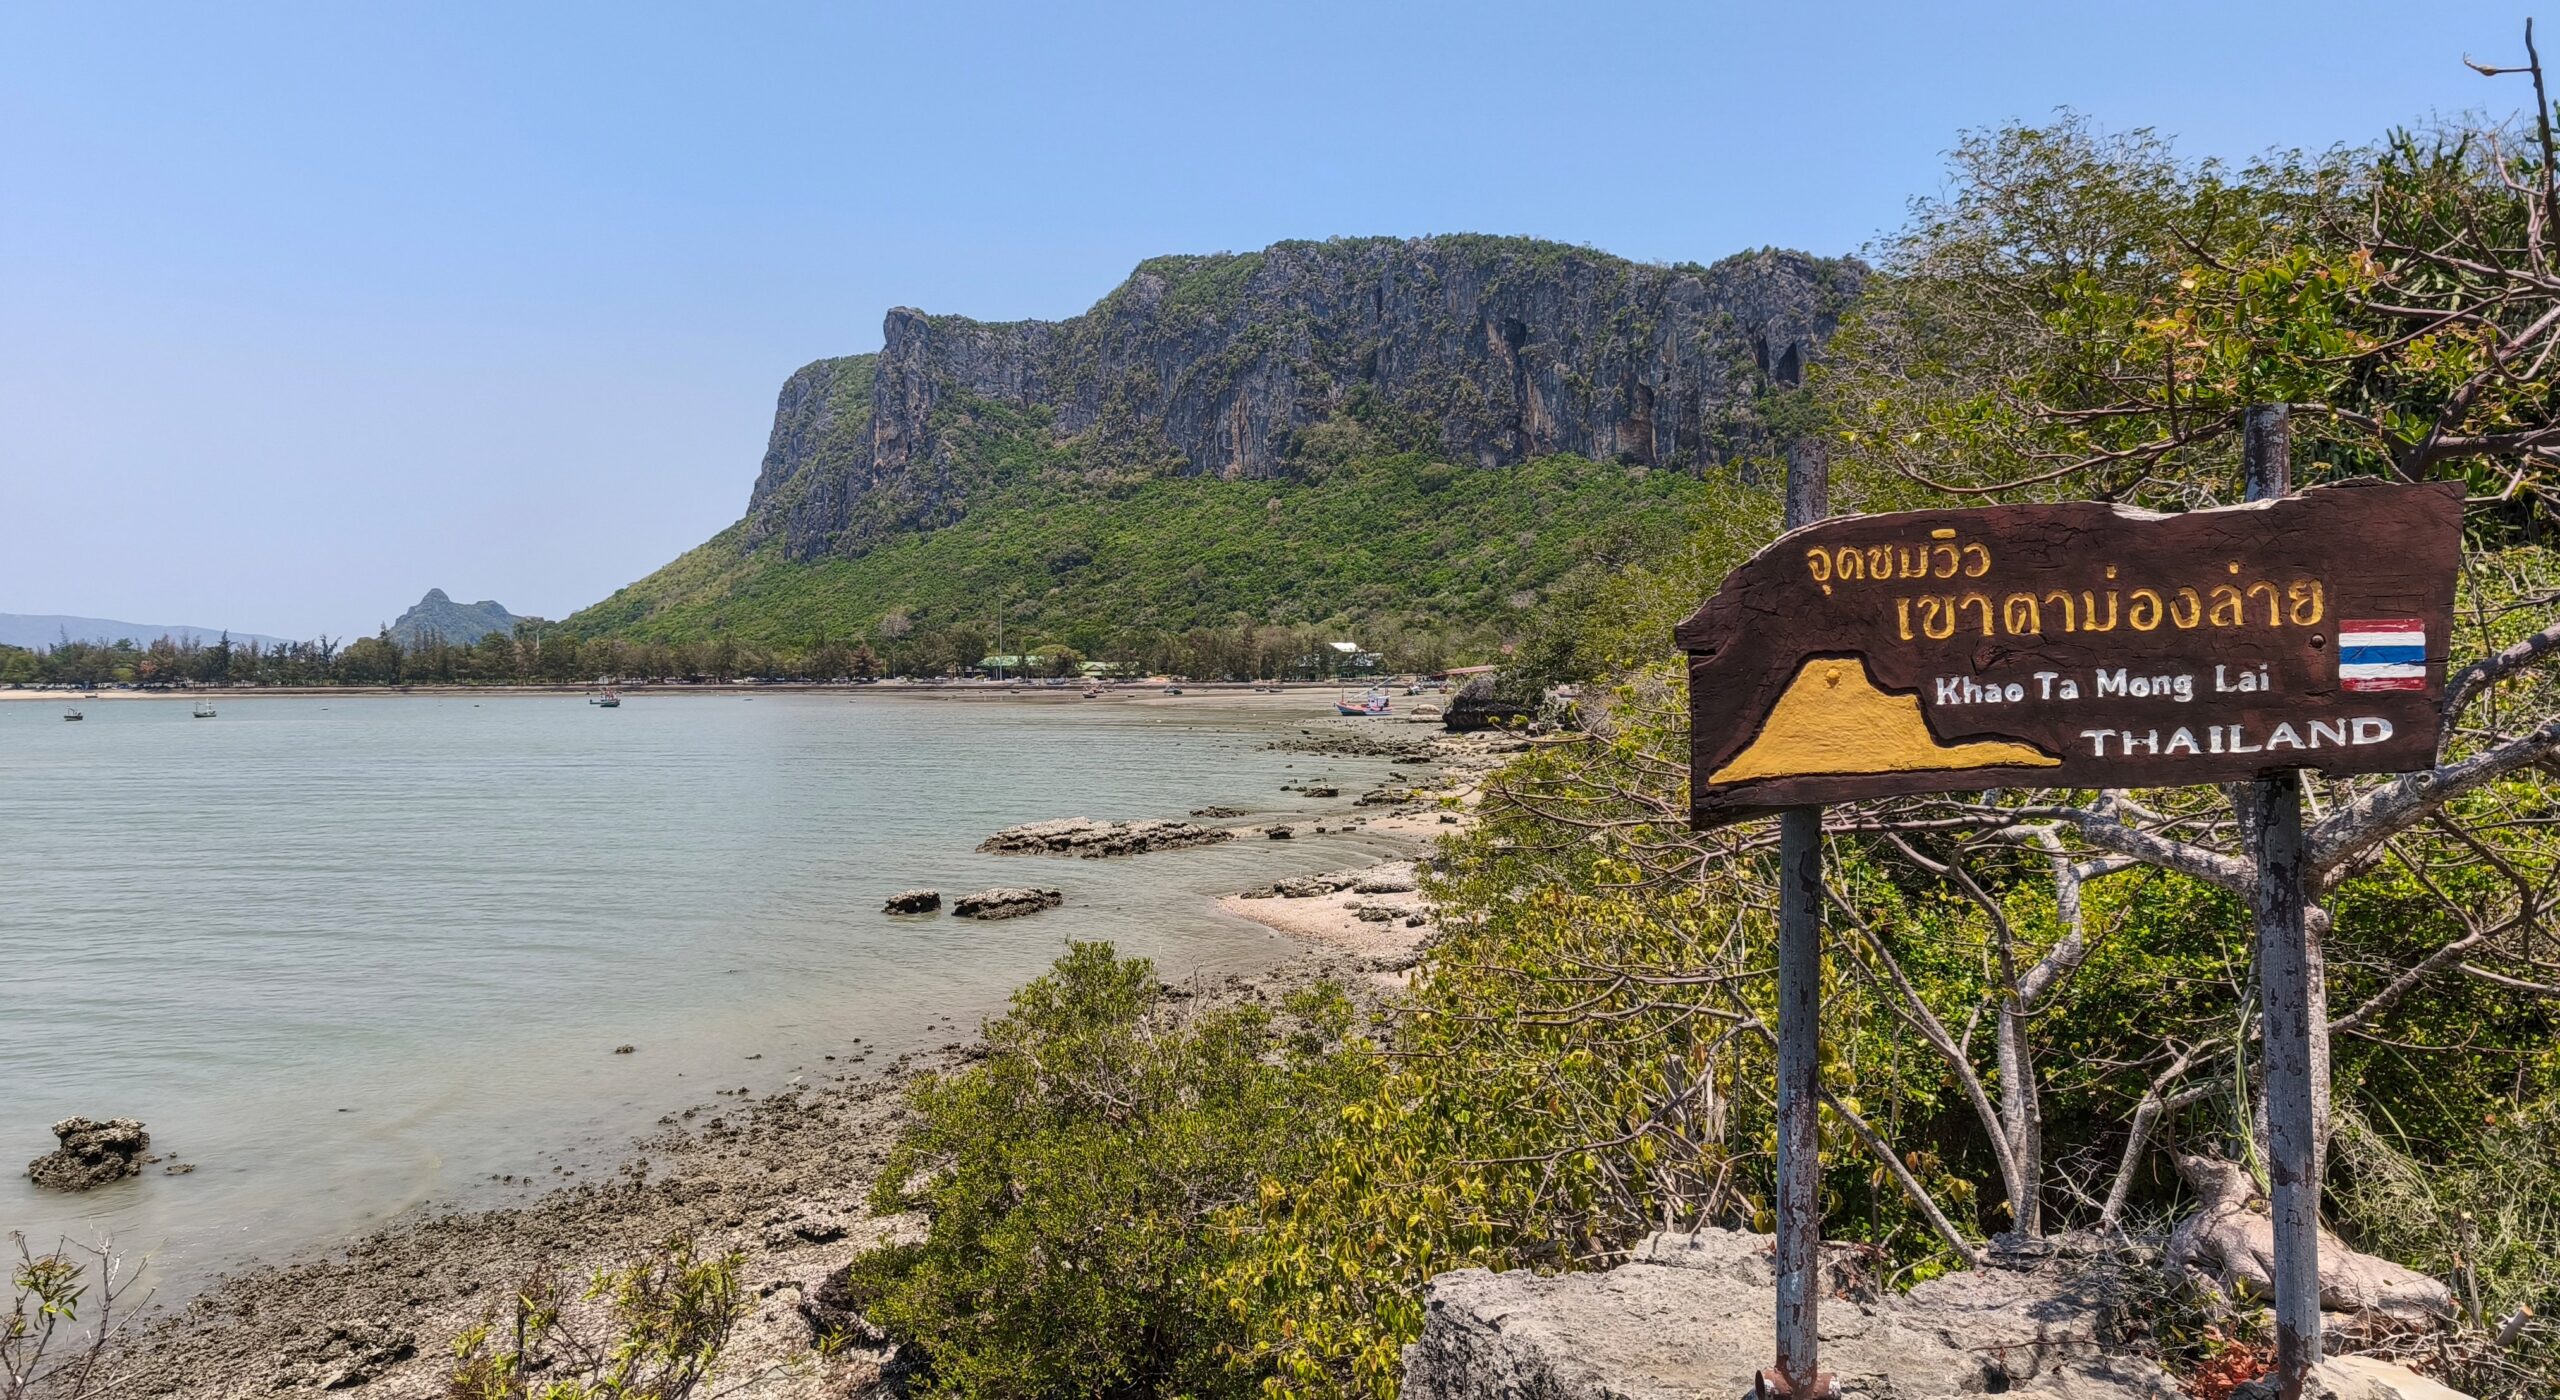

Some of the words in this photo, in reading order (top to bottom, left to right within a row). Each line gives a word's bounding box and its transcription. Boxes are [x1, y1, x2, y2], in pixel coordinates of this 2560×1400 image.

[1807, 528, 1992, 596] จุดชมวิว
[1935, 675, 2025, 705] Khao
[2033, 671, 2080, 700] Ta
[2095, 667, 2194, 703] Mong
[2214, 663, 2271, 694] Lai
[2079, 715, 2394, 757] THAILAND
